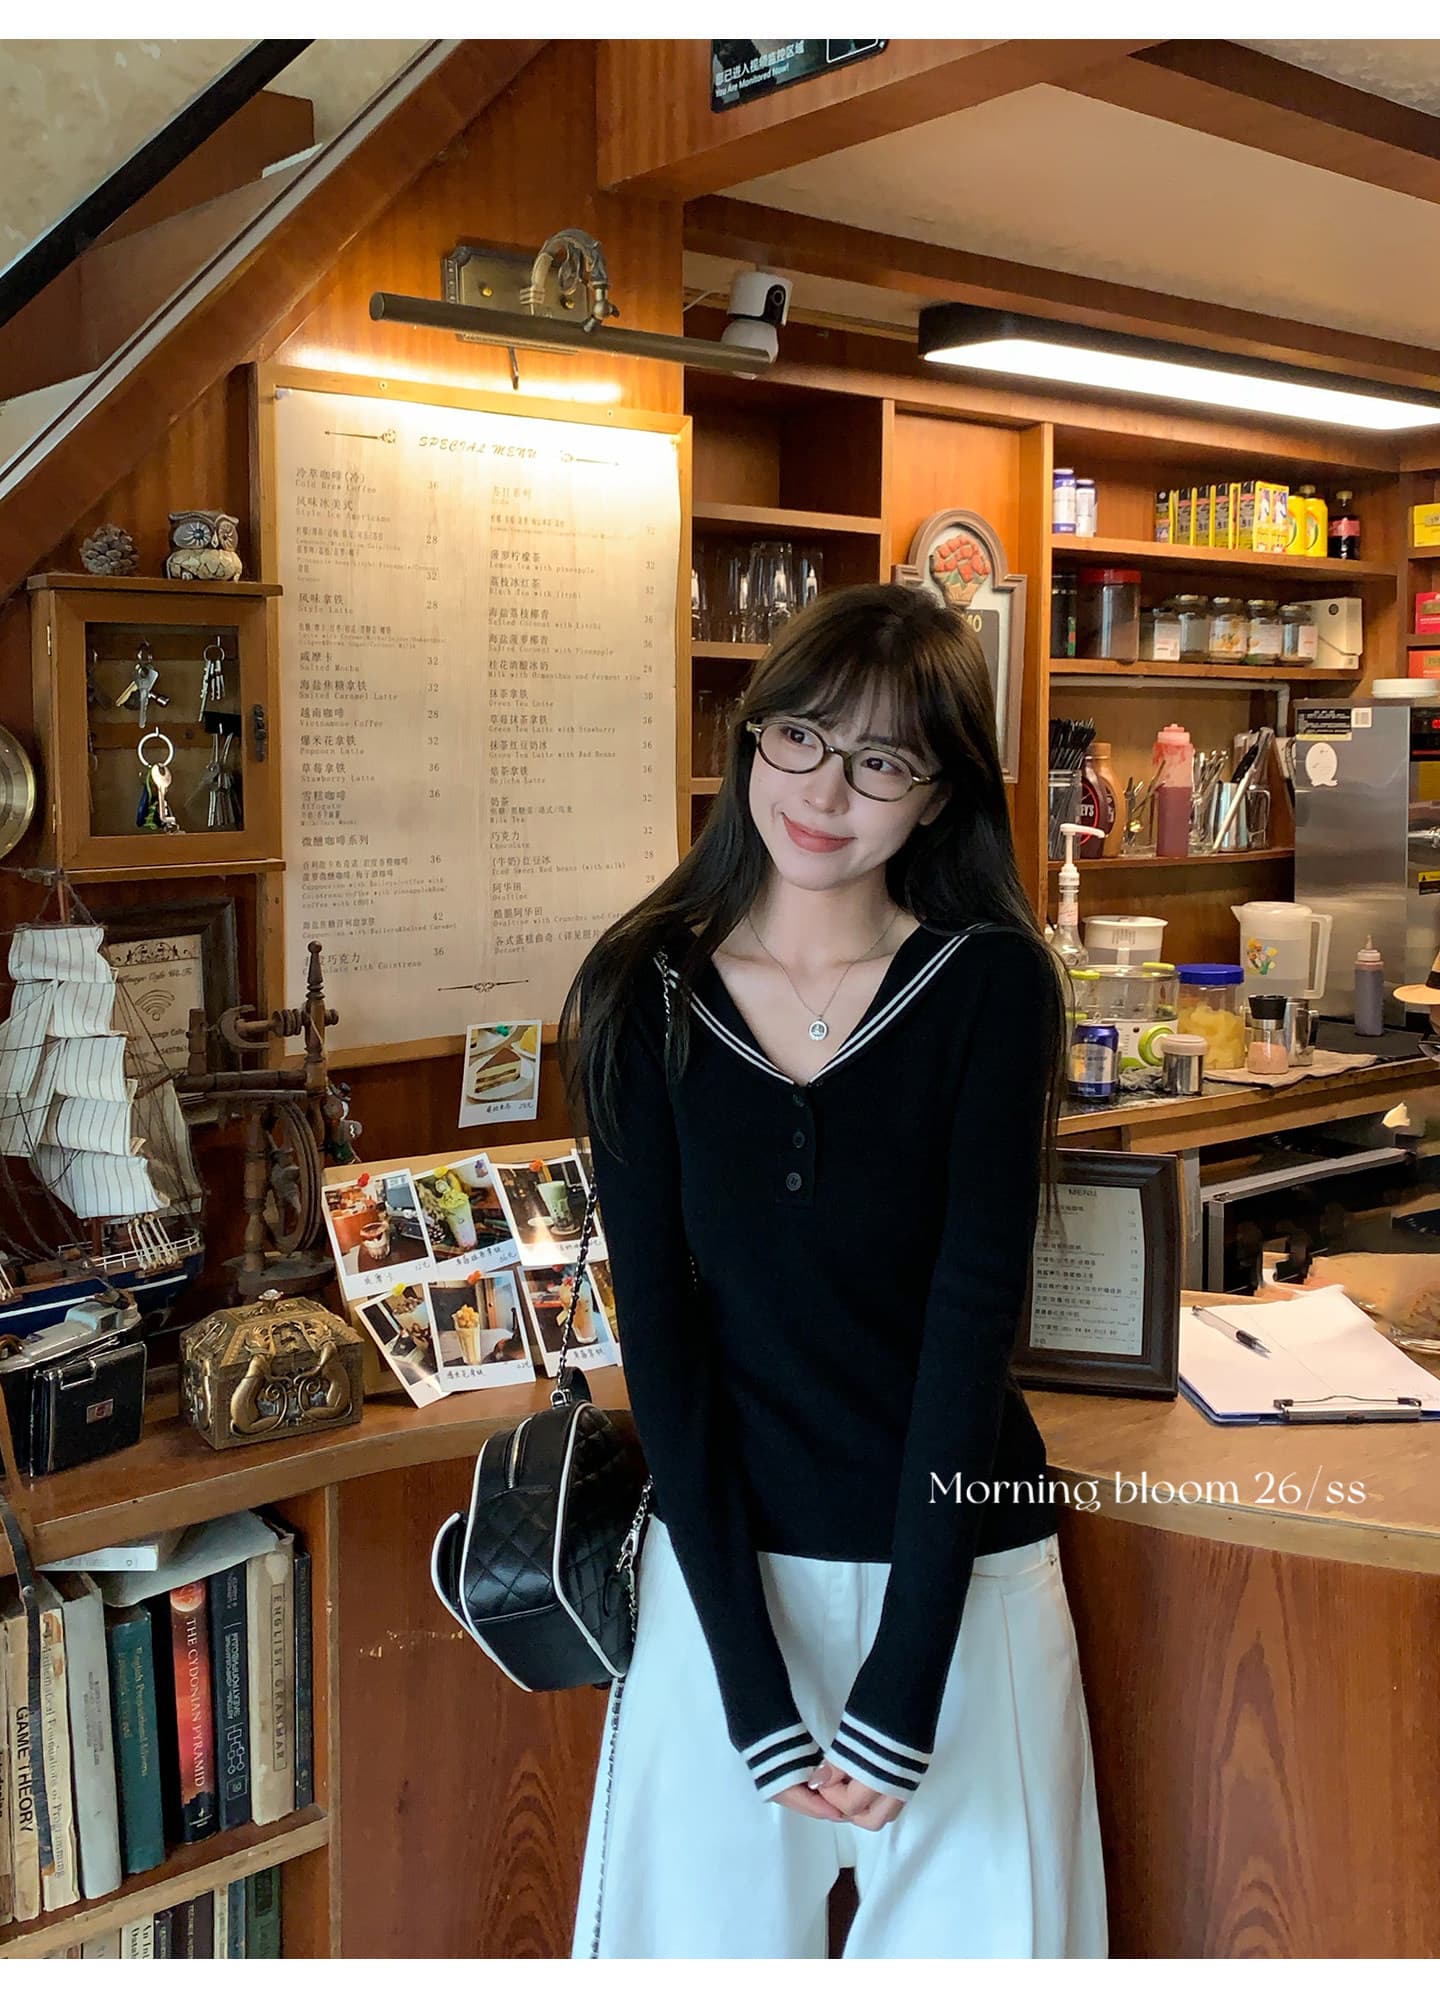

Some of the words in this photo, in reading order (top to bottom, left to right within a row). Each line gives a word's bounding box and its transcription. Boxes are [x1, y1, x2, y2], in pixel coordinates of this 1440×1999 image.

[715, 40, 804, 87] 您已进入视频监控区域
[727, 83, 738, 93] Are
[738, 68, 772, 89] Monitored
[419, 436, 486, 453] SPECIAL
[492, 444, 537, 459] MENU
[296, 479, 316, 489] Cold
[425, 535, 438, 545] 28
[425, 572, 438, 581] 32
[426, 600, 439, 610] 28
[427, 656, 439, 666] 32
[299, 679, 367, 691] 海盐焦糖拿铁
[427, 683, 439, 692] 32
[334, 692, 369, 701] Caramel
[373, 693, 398, 701] Latte
[489, 688, 528, 700] 抹茶拿铁
[300, 707, 344, 719] 越南咖啡
[427, 710, 439, 719] 28
[489, 714, 548, 725] 草莓抹茶拿铁
[642, 716, 653, 725] 36
[300, 735, 357, 746] 爆米花拿铁
[427, 736, 439, 745] 32
[642, 741, 653, 750] 36
[300, 747, 336, 756] Popcorn
[340, 747, 364, 755] Latte
[301, 762, 346, 774] 草莓拿铁
[428, 763, 440, 773] 36
[642, 765, 653, 774] 36
[428, 789, 440, 799] 36
[642, 793, 653, 803] 32
[490, 797, 510, 807] 奶茶
[642, 826, 653, 835] 32
[490, 831, 520, 842] 巧克力
[430, 854, 442, 864] 36
[492, 882, 522, 893] 阿华田
[432, 912, 444, 921] 42
[433, 947, 445, 957] 36
[185, 1618, 197, 1646] THE
[273, 1595, 284, 1667] ENGLISH
[187, 1650, 201, 1723] CYDONIAN
[274, 1679, 285, 1760] GRAMMAR
[16, 1707, 29, 1760] GAME
[193, 1725, 206, 1787] PYRAMID
[18, 1765, 33, 1832] THEORY
[142, 1924, 151, 1939] An
